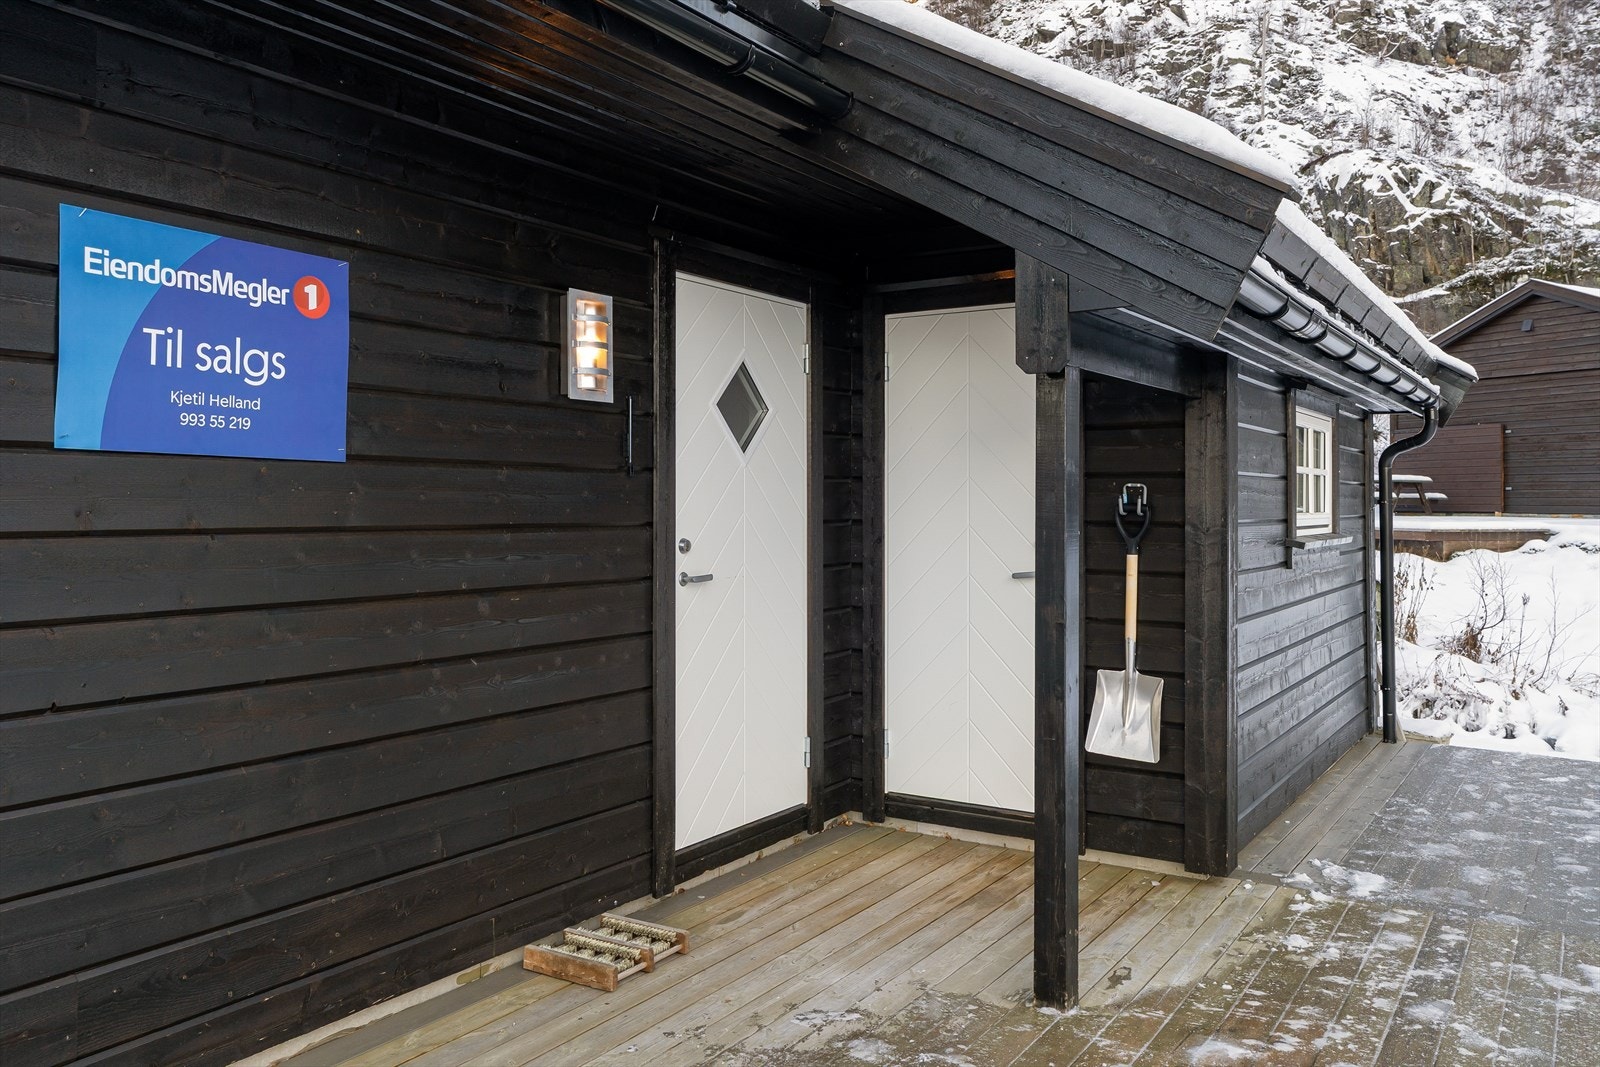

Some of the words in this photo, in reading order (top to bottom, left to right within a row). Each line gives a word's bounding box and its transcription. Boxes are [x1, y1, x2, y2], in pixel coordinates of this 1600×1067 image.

[83, 246, 290, 308] EiendomsMegler
[304, 284, 318, 311] 1
[142, 326, 183, 369] Til
[195, 337, 286, 387] salgs
[170, 390, 205, 408] Kjetil
[209, 394, 261, 410] Helland
[179, 412, 206, 427] 993
[209, 414, 226, 429] 55
[229, 415, 251, 430] 219
